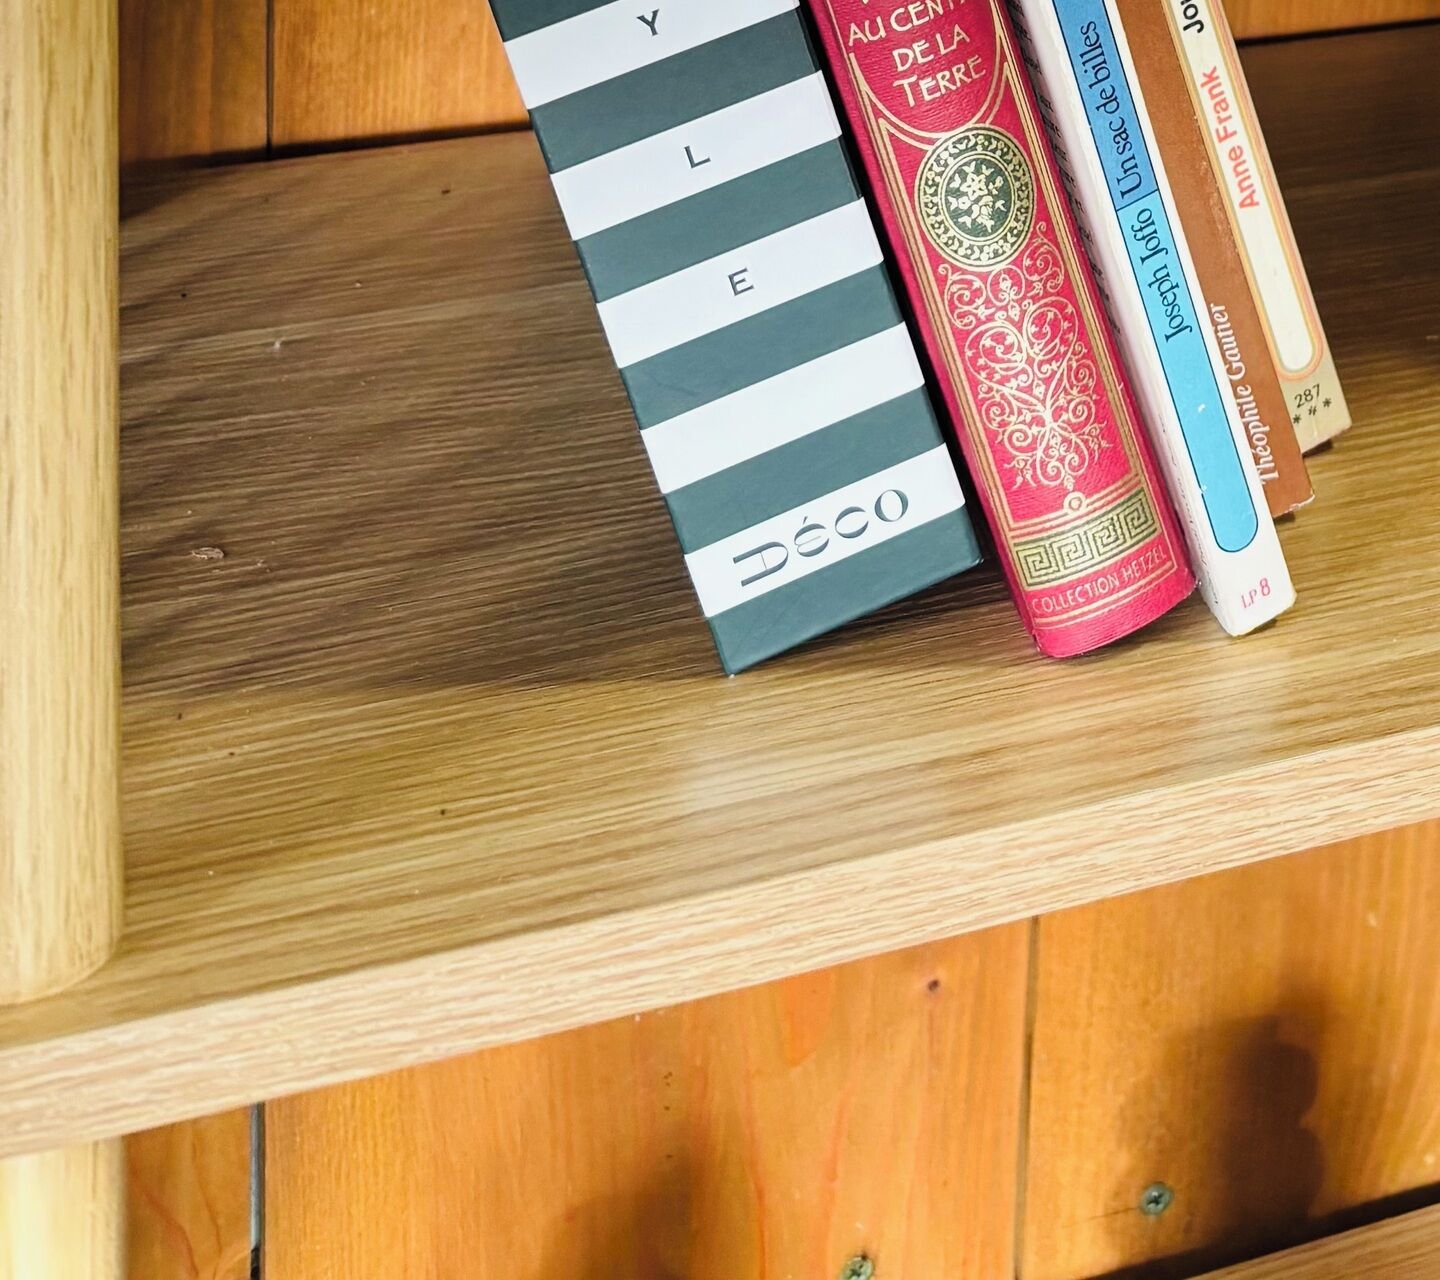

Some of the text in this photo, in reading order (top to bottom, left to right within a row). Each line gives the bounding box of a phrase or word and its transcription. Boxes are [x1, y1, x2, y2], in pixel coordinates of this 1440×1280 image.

[847, 13, 887, 48] AU
[893, 25, 971, 71] DE LA
[895, 55, 987, 107] TERRE
[1079, 21, 1142, 200] Un sac de billes
[1200, 65, 1260, 209] Anne Frank
[1131, 208, 1192, 343] Joseph Joffo
[1294, 383, 1320, 408] 287
[1032, 544, 1167, 614] COLLECTION HETZEL
[1241, 577, 1272, 609] LP 8
